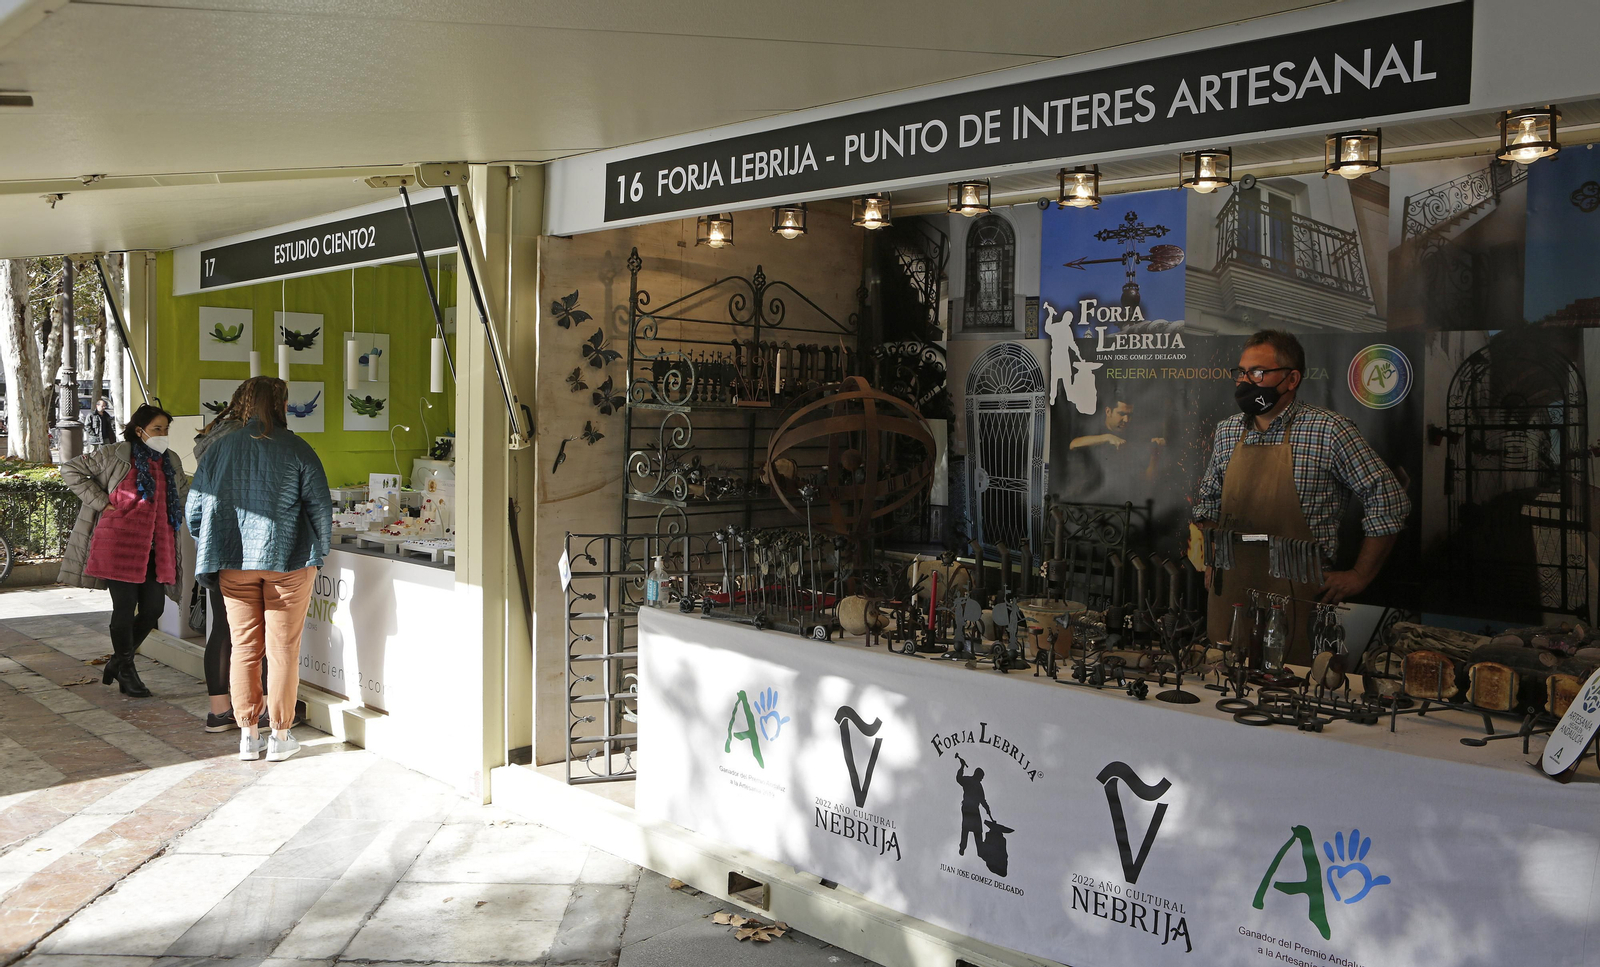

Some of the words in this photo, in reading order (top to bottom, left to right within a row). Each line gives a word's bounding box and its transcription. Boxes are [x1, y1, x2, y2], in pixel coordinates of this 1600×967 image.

[617, 172, 644, 204] 16
[656, 159, 724, 197] FORJA
[730, 142, 818, 184] LEBRIJA
[844, 119, 948, 166] PUNTO
[959, 109, 1001, 148] DE
[1013, 84, 1155, 141] INTERES
[1167, 39, 1437, 118] ARTESANAL
[204, 257, 216, 277] 17
[274, 236, 320, 264] ESTUDIO
[322, 225, 376, 256] CIENTO2
[1078, 298, 1145, 325] FORJA
[1094, 326, 1186, 352] LEBRIJA
[1106, 368, 1157, 379] REJERIA
[1160, 367, 1232, 379] TRADICION
[815, 796, 832, 810] 2022
[834, 803, 851, 815] AÑO
[853, 808, 897, 830] CULTURAL
[814, 806, 902, 861] NEBRIJA
[939, 863, 956, 874] JUAN
[956, 868, 970, 879] JOSE
[970, 873, 993, 887] GOMEZ
[994, 880, 1025, 897] DELGADO
[1071, 872, 1095, 888] 2022
[1098, 881, 1122, 895] AÑO
[1125, 887, 1187, 914] CULTURAL
[1071, 884, 1193, 953] NEBRIJA
[1238, 925, 1277, 944] Ganador
[1278, 938, 1292, 949] del
[1294, 942, 1327, 961] Premio
[1265, 948, 1274, 957] la
